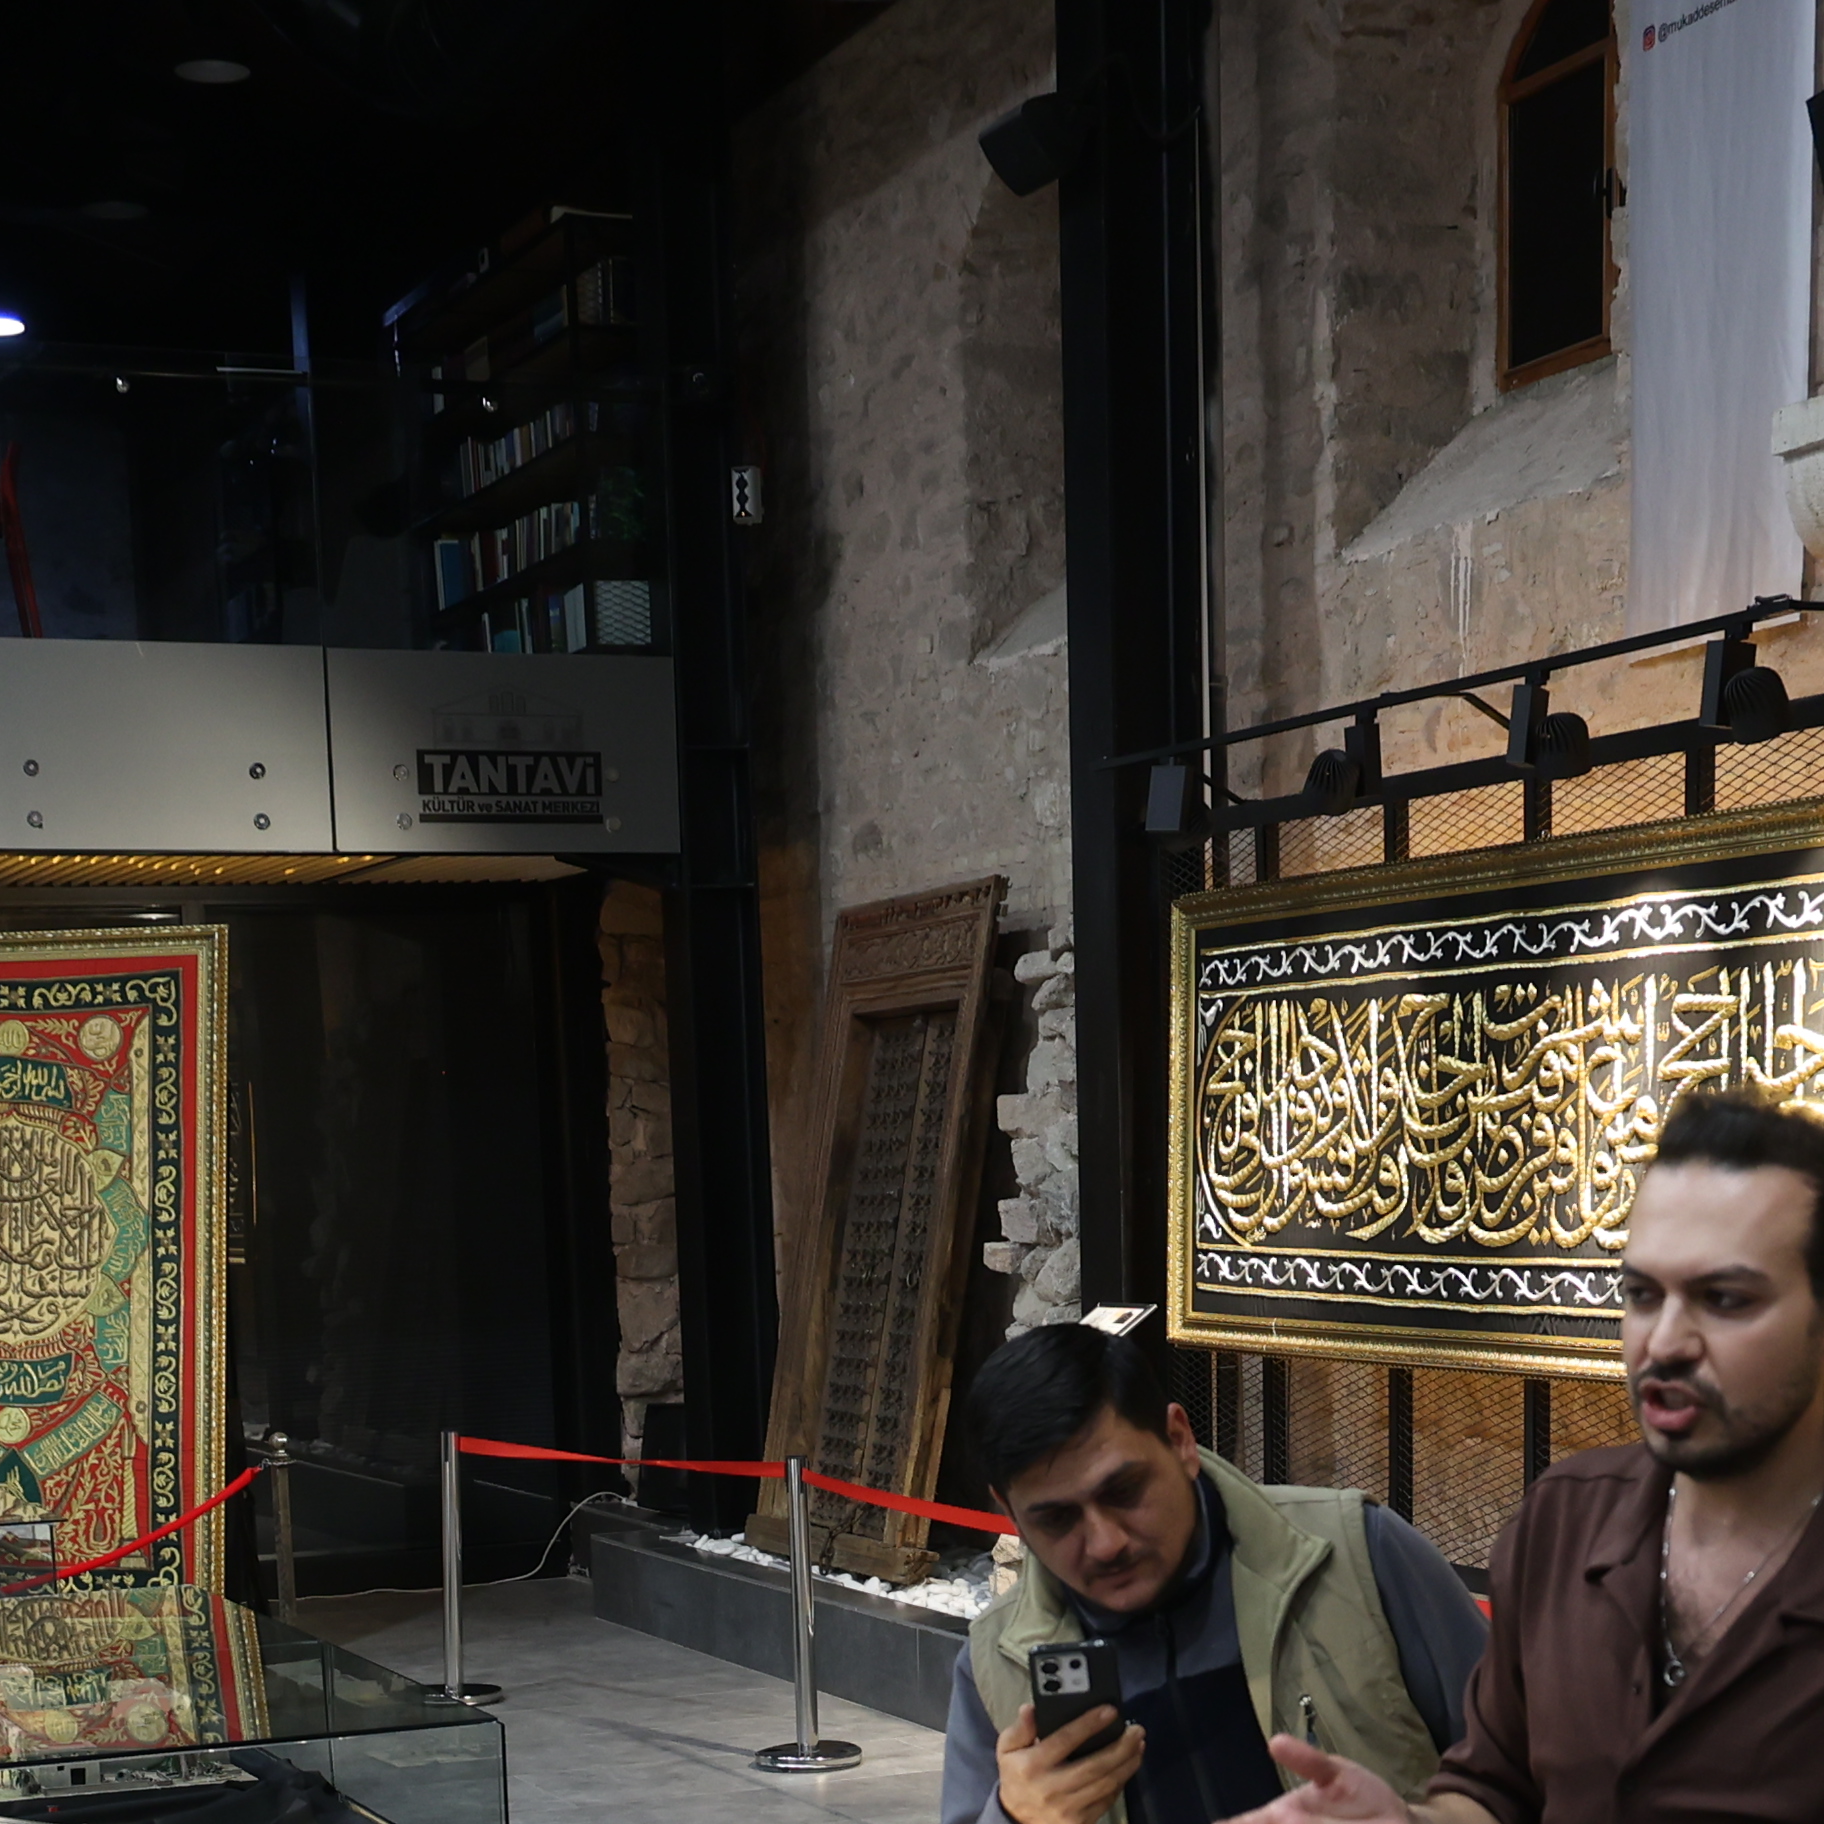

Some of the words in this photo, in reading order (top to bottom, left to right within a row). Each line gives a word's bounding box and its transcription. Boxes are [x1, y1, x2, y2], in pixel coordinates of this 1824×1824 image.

[422, 797, 475, 813] KÜLTÜR
[478, 803, 493, 813] ve
[496, 799, 539, 813] SANAT
